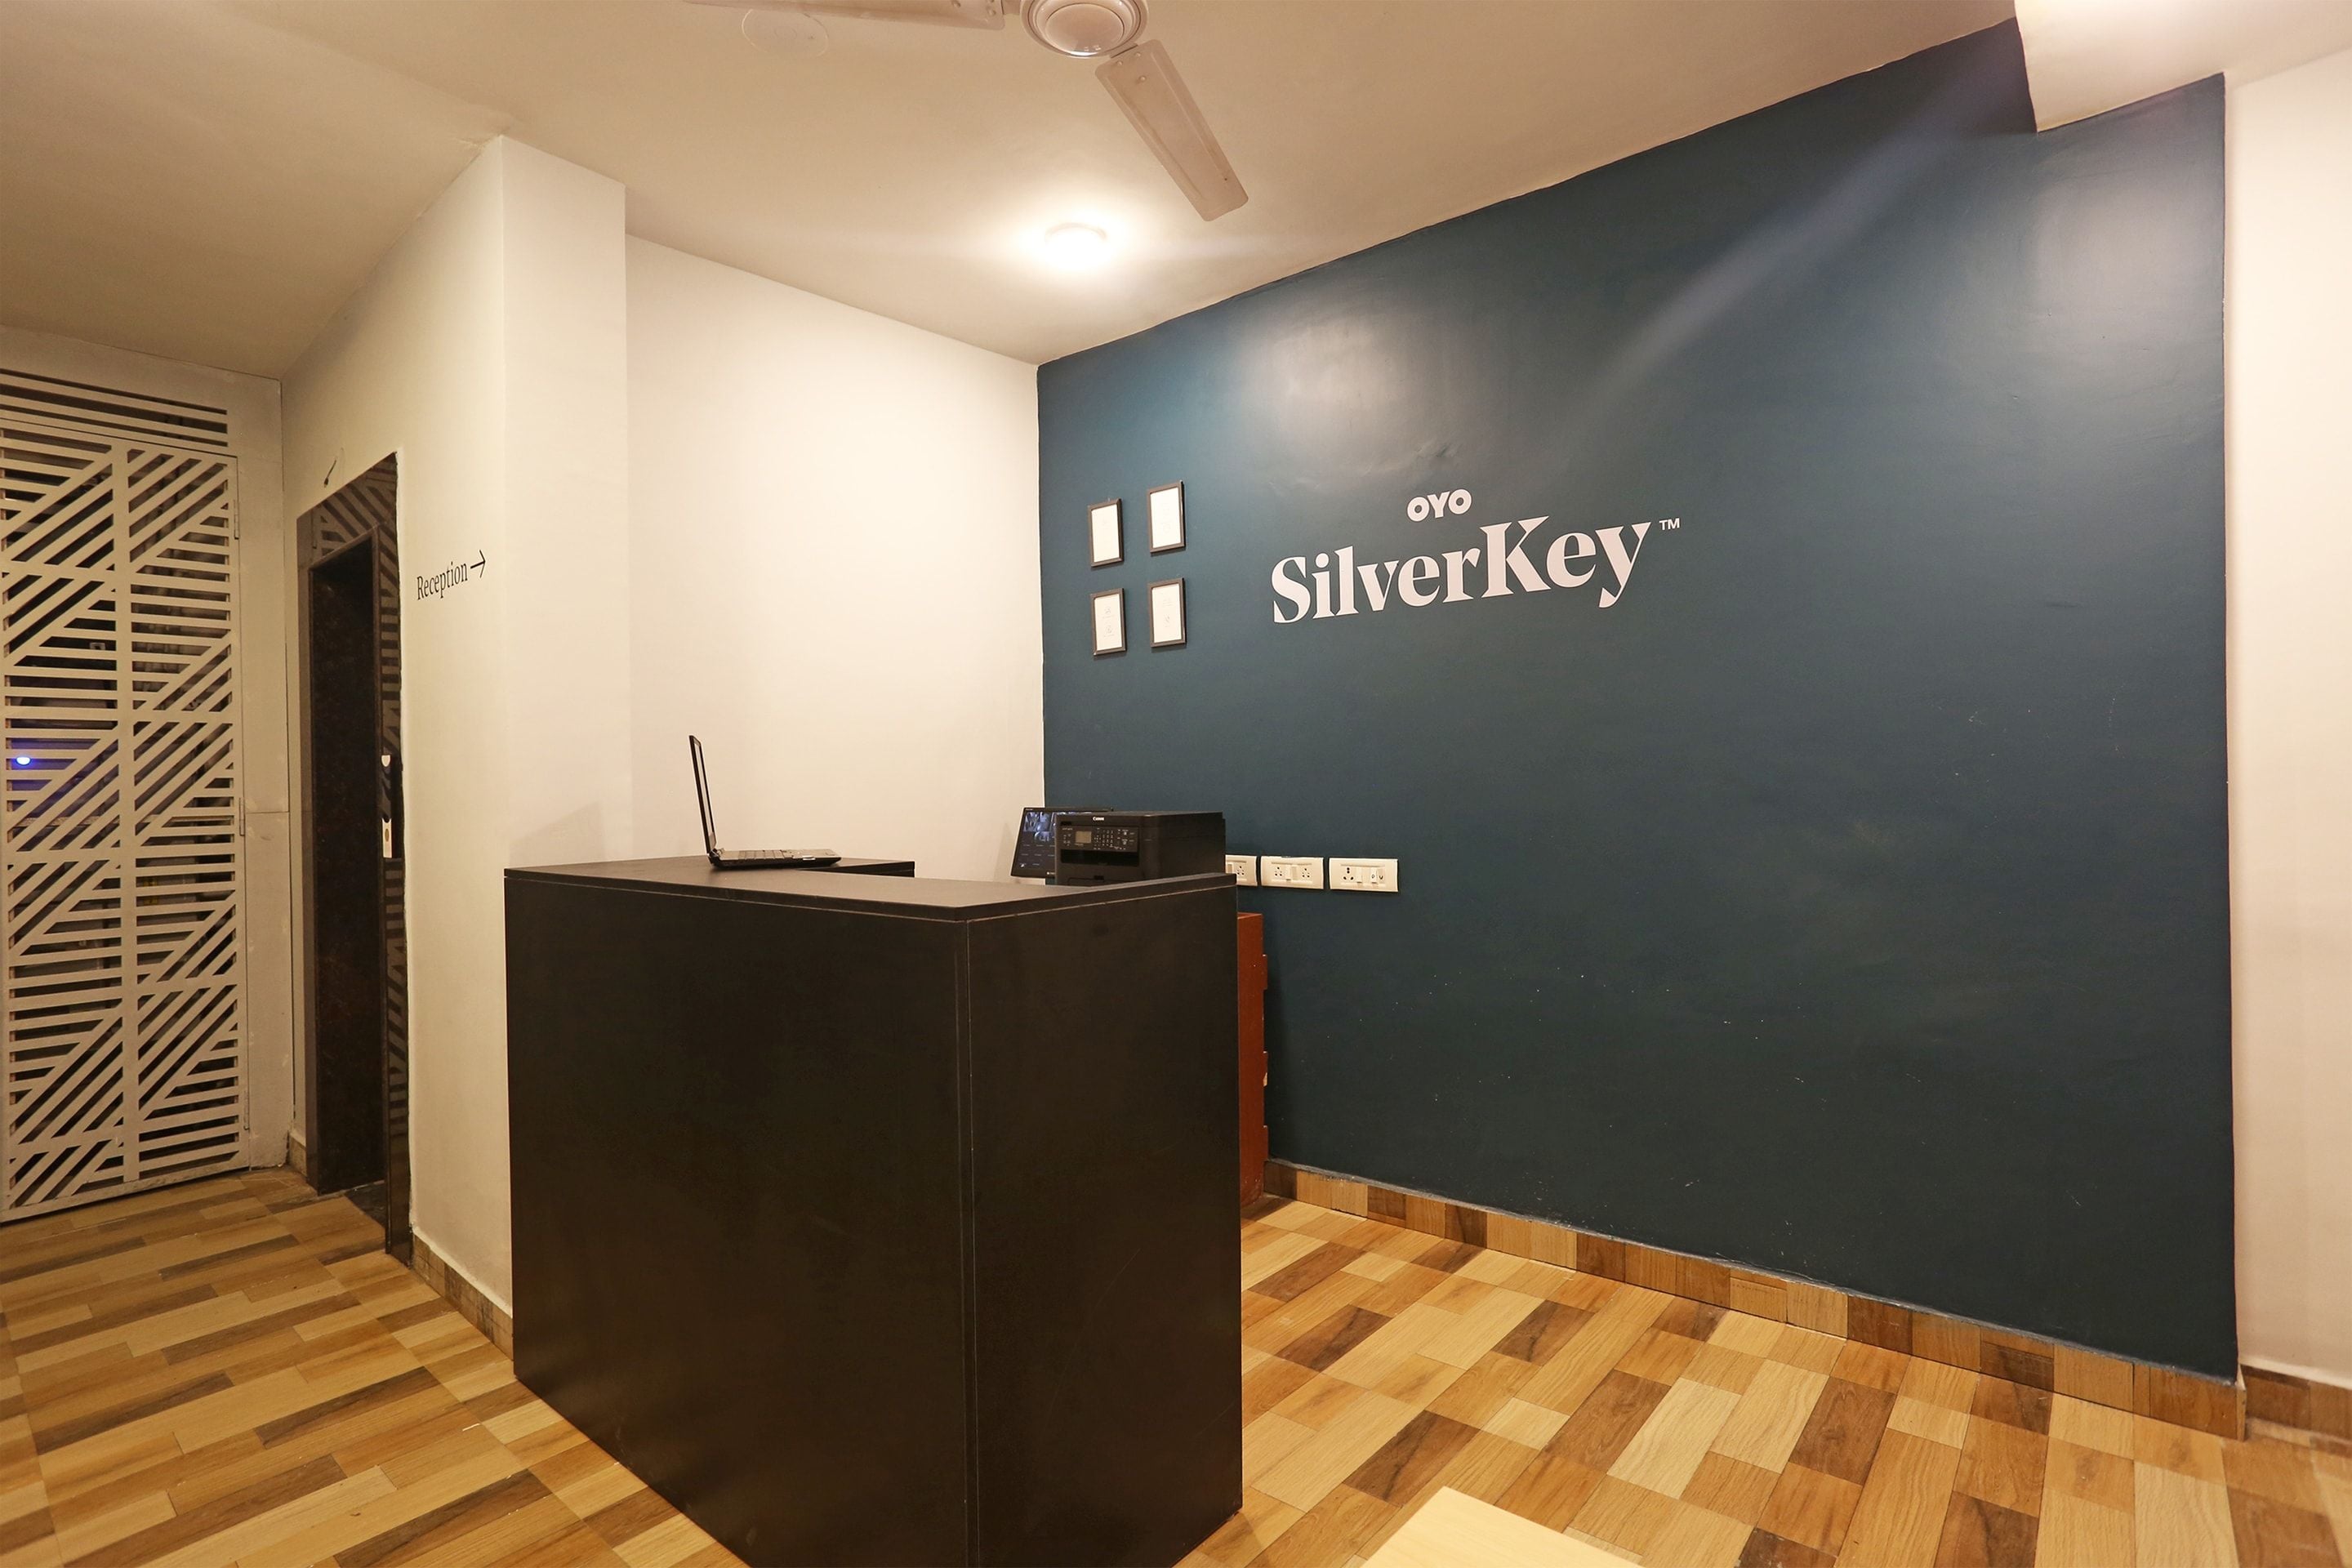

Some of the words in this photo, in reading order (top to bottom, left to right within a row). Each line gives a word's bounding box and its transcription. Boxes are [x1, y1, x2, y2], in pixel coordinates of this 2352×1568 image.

[1407, 488, 1472, 522] OYO
[416, 561, 468, 600] Reception
[1271, 515, 1651, 624] SilverKey
